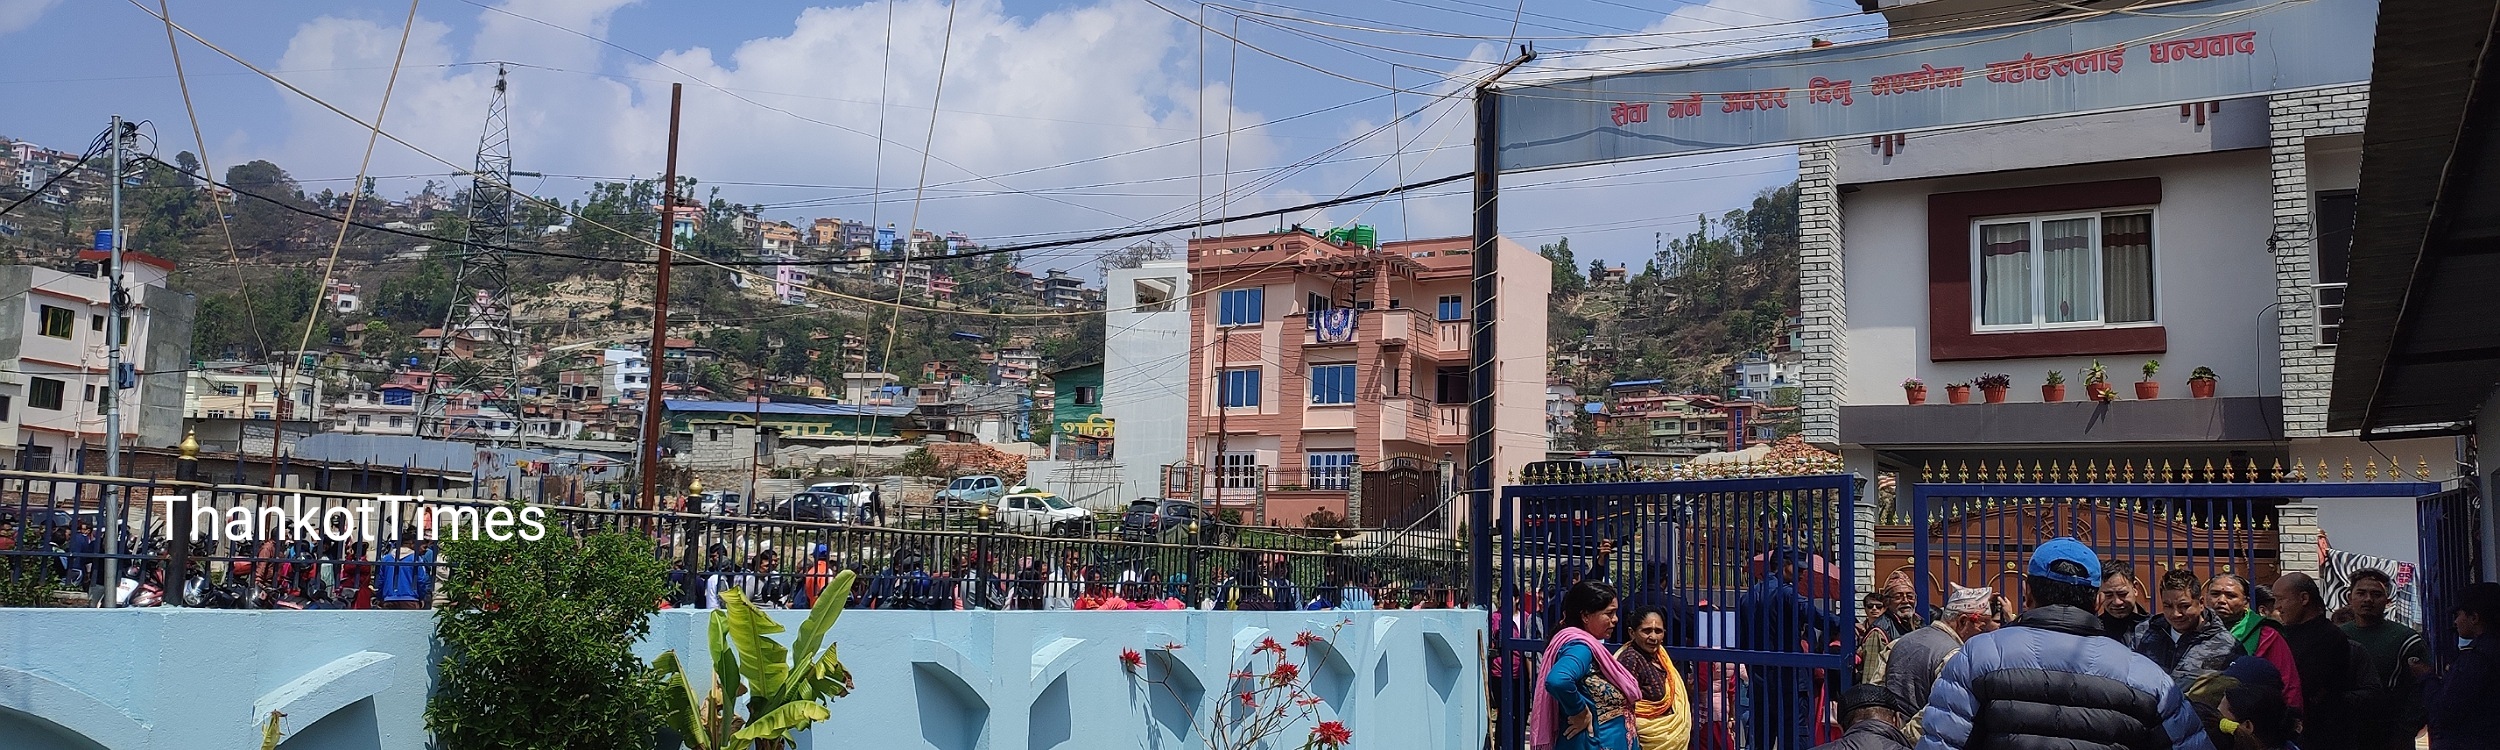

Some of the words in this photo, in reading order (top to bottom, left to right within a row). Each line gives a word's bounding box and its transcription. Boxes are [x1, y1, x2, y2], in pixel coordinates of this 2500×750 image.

[1610, 102, 1649, 127] सेवा
[1720, 87, 1790, 114] अवसर
[1808, 76, 1853, 106] दिनु
[2149, 31, 2257, 64] धन्यवाद
